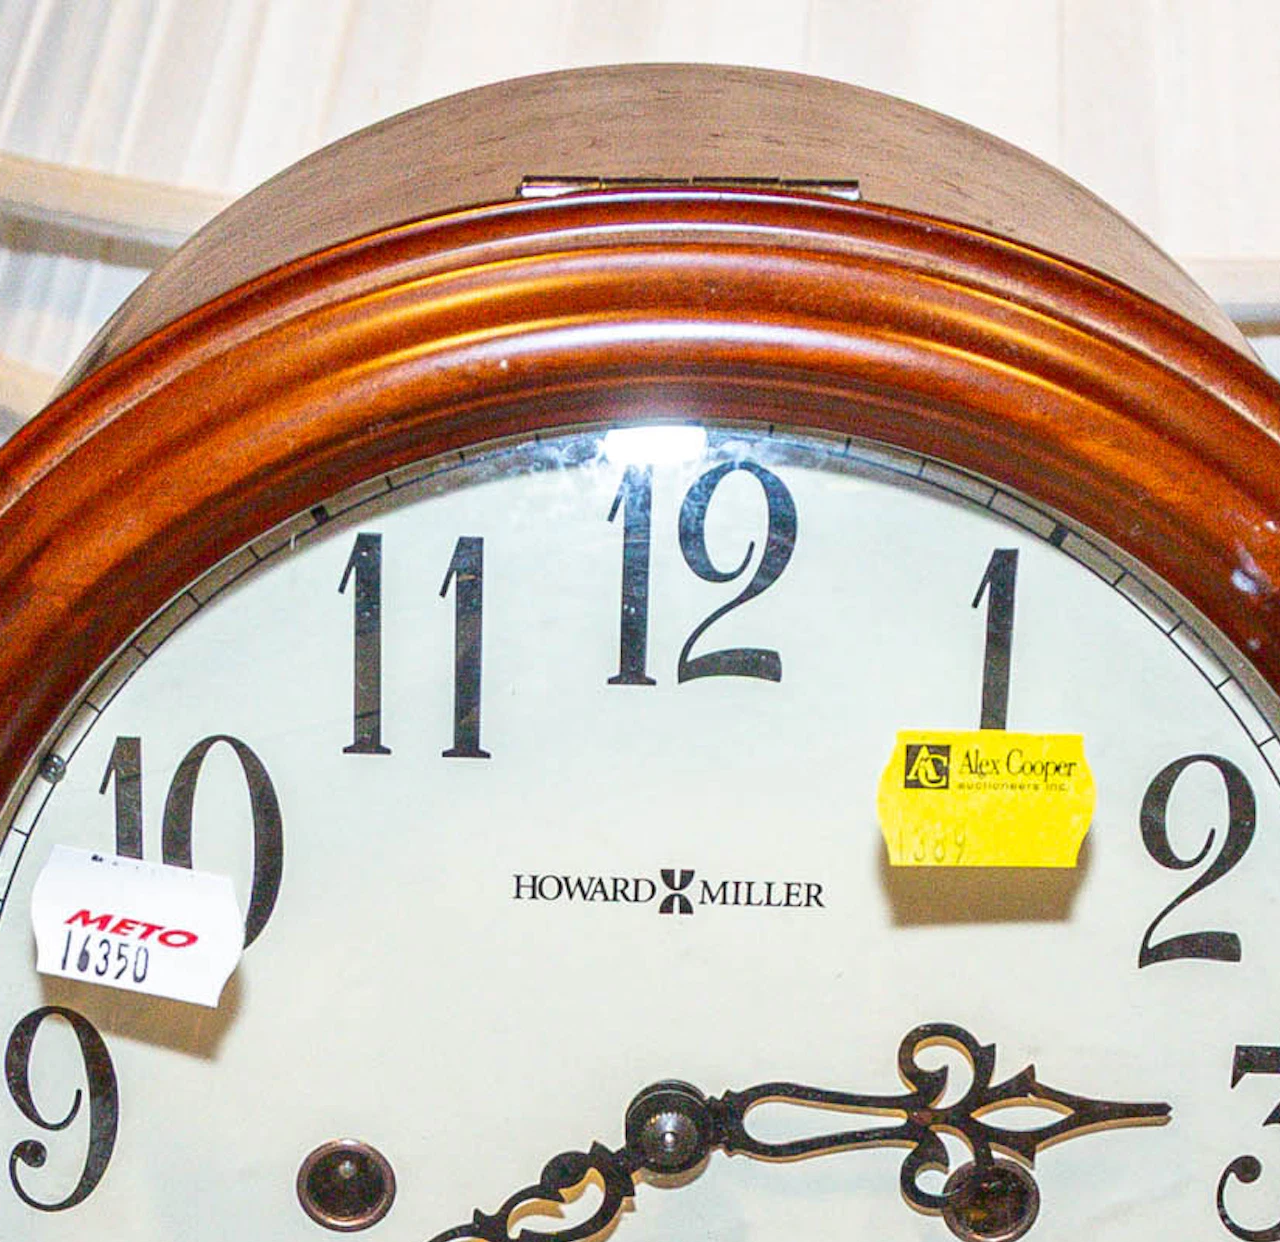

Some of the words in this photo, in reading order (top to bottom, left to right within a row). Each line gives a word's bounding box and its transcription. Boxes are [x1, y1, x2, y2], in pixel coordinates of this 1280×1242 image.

[606, 460, 798, 686] 12
[337, 532, 492, 759] 11
[971, 548, 1019, 730] 1
[957, 780, 1040, 791] auctioneers
[959, 748, 1000, 777] Alex
[1006, 748, 1078, 783] Cooper
[513, 873, 656, 903] HOWARD
[699, 879, 826, 908] MILLER
[1138, 754, 1257, 968] 2
[60, 928, 150, 984] 16350
[64, 908, 199, 948] METO
[4, 1005, 120, 1212] 9
